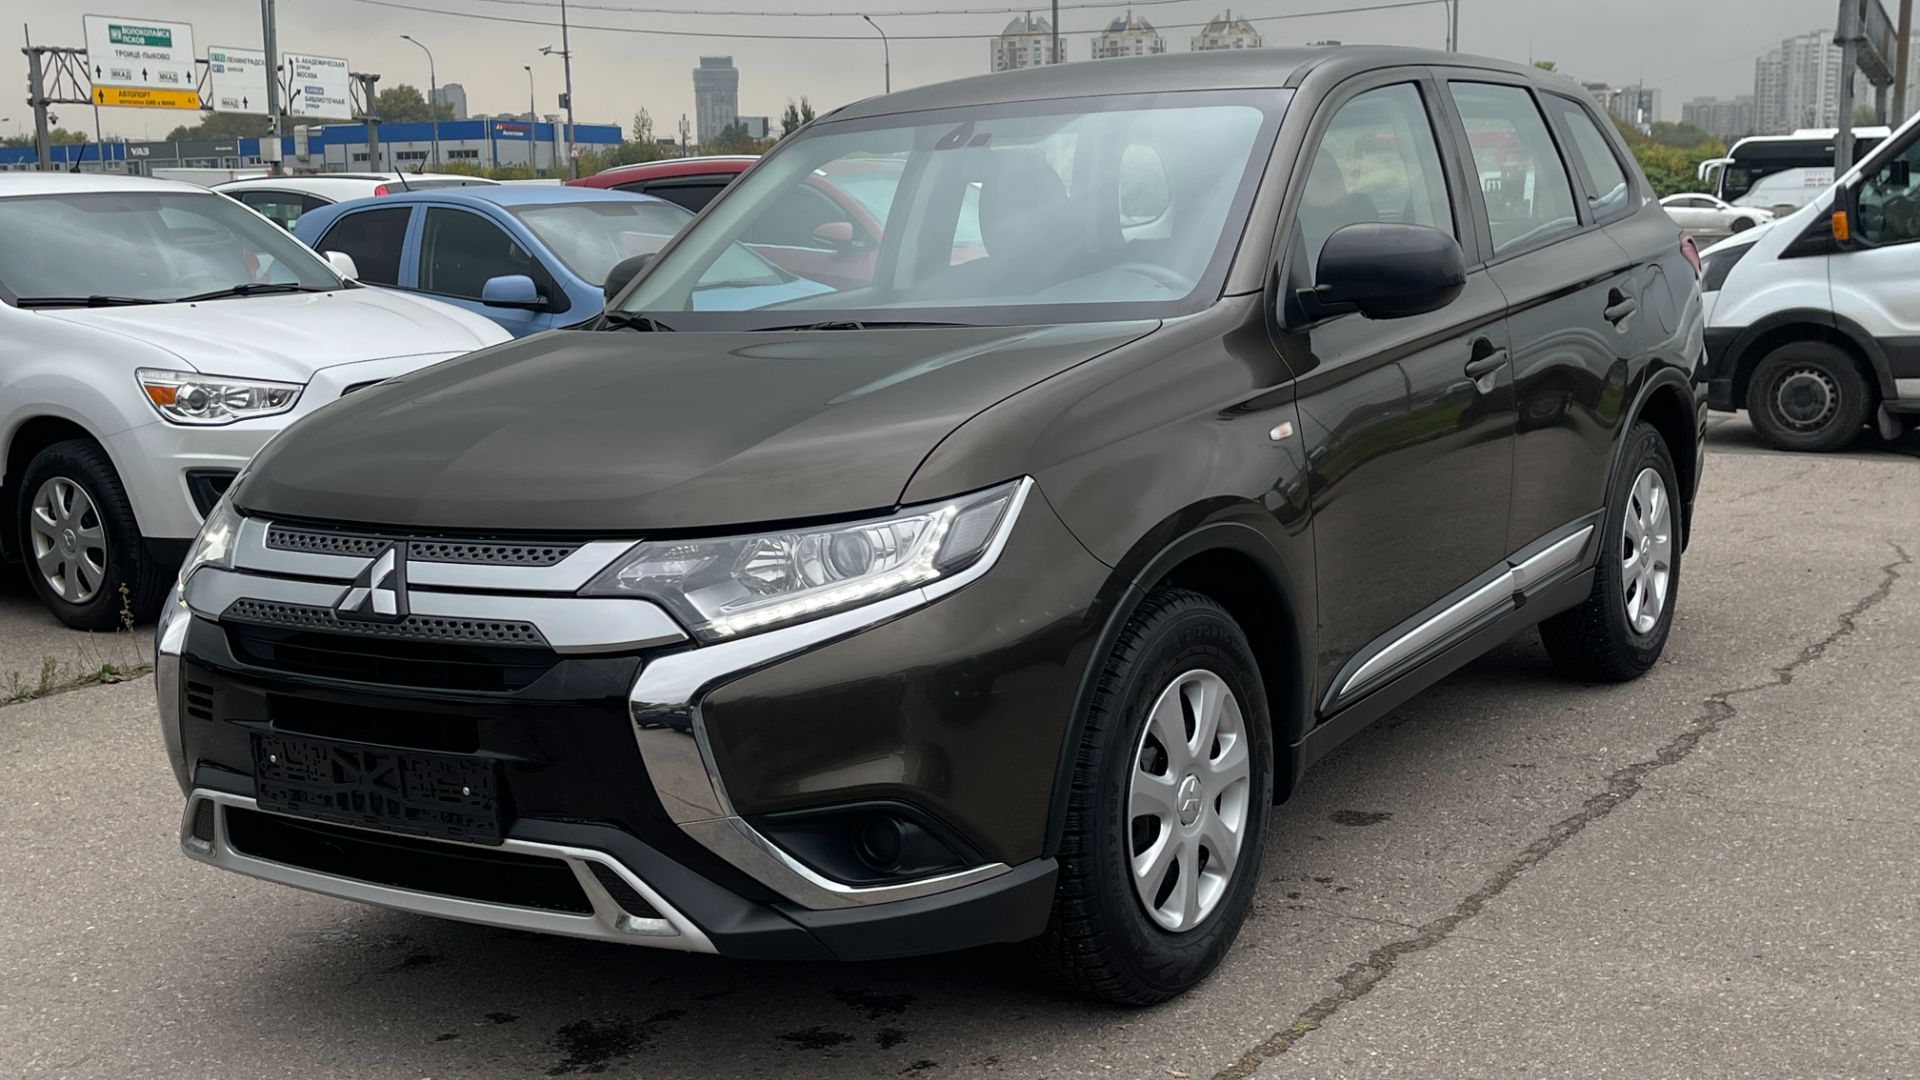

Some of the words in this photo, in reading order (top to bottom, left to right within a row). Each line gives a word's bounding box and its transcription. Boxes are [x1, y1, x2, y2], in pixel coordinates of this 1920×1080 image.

[122, 26, 170, 38] ВОЛОКОЛАМСК
[122, 35, 145, 44] ПСКОВ
[301, 58, 345, 68] АКАДЕМИЧЕСКАЯ
[296, 71, 318, 79] МОСКВА
[130, 147, 150, 156] УАЗ
